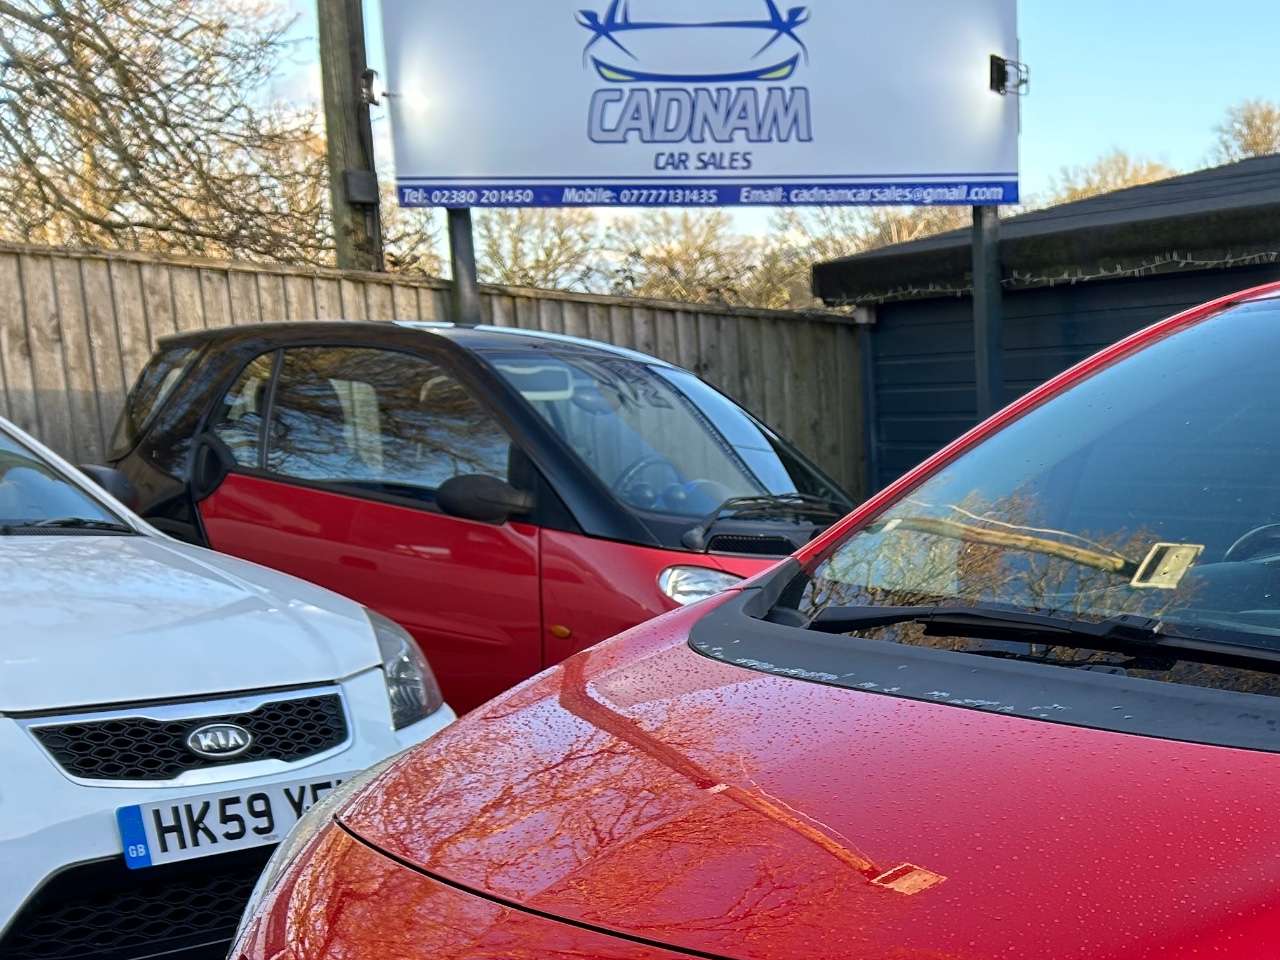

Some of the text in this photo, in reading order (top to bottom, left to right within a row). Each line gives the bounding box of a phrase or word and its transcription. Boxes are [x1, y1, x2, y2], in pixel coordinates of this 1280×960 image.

[587, 86, 813, 144] CADNAM
[653, 151, 752, 171] CAR SALES
[402, 184, 1004, 204] Tel: 02380 201450 Mobile: 07777131435 Email: cadnamcarsales@gmail.com
[198, 729, 243, 752] KIA
[151, 792, 275, 853] HK59
[128, 844, 147, 858] GB
